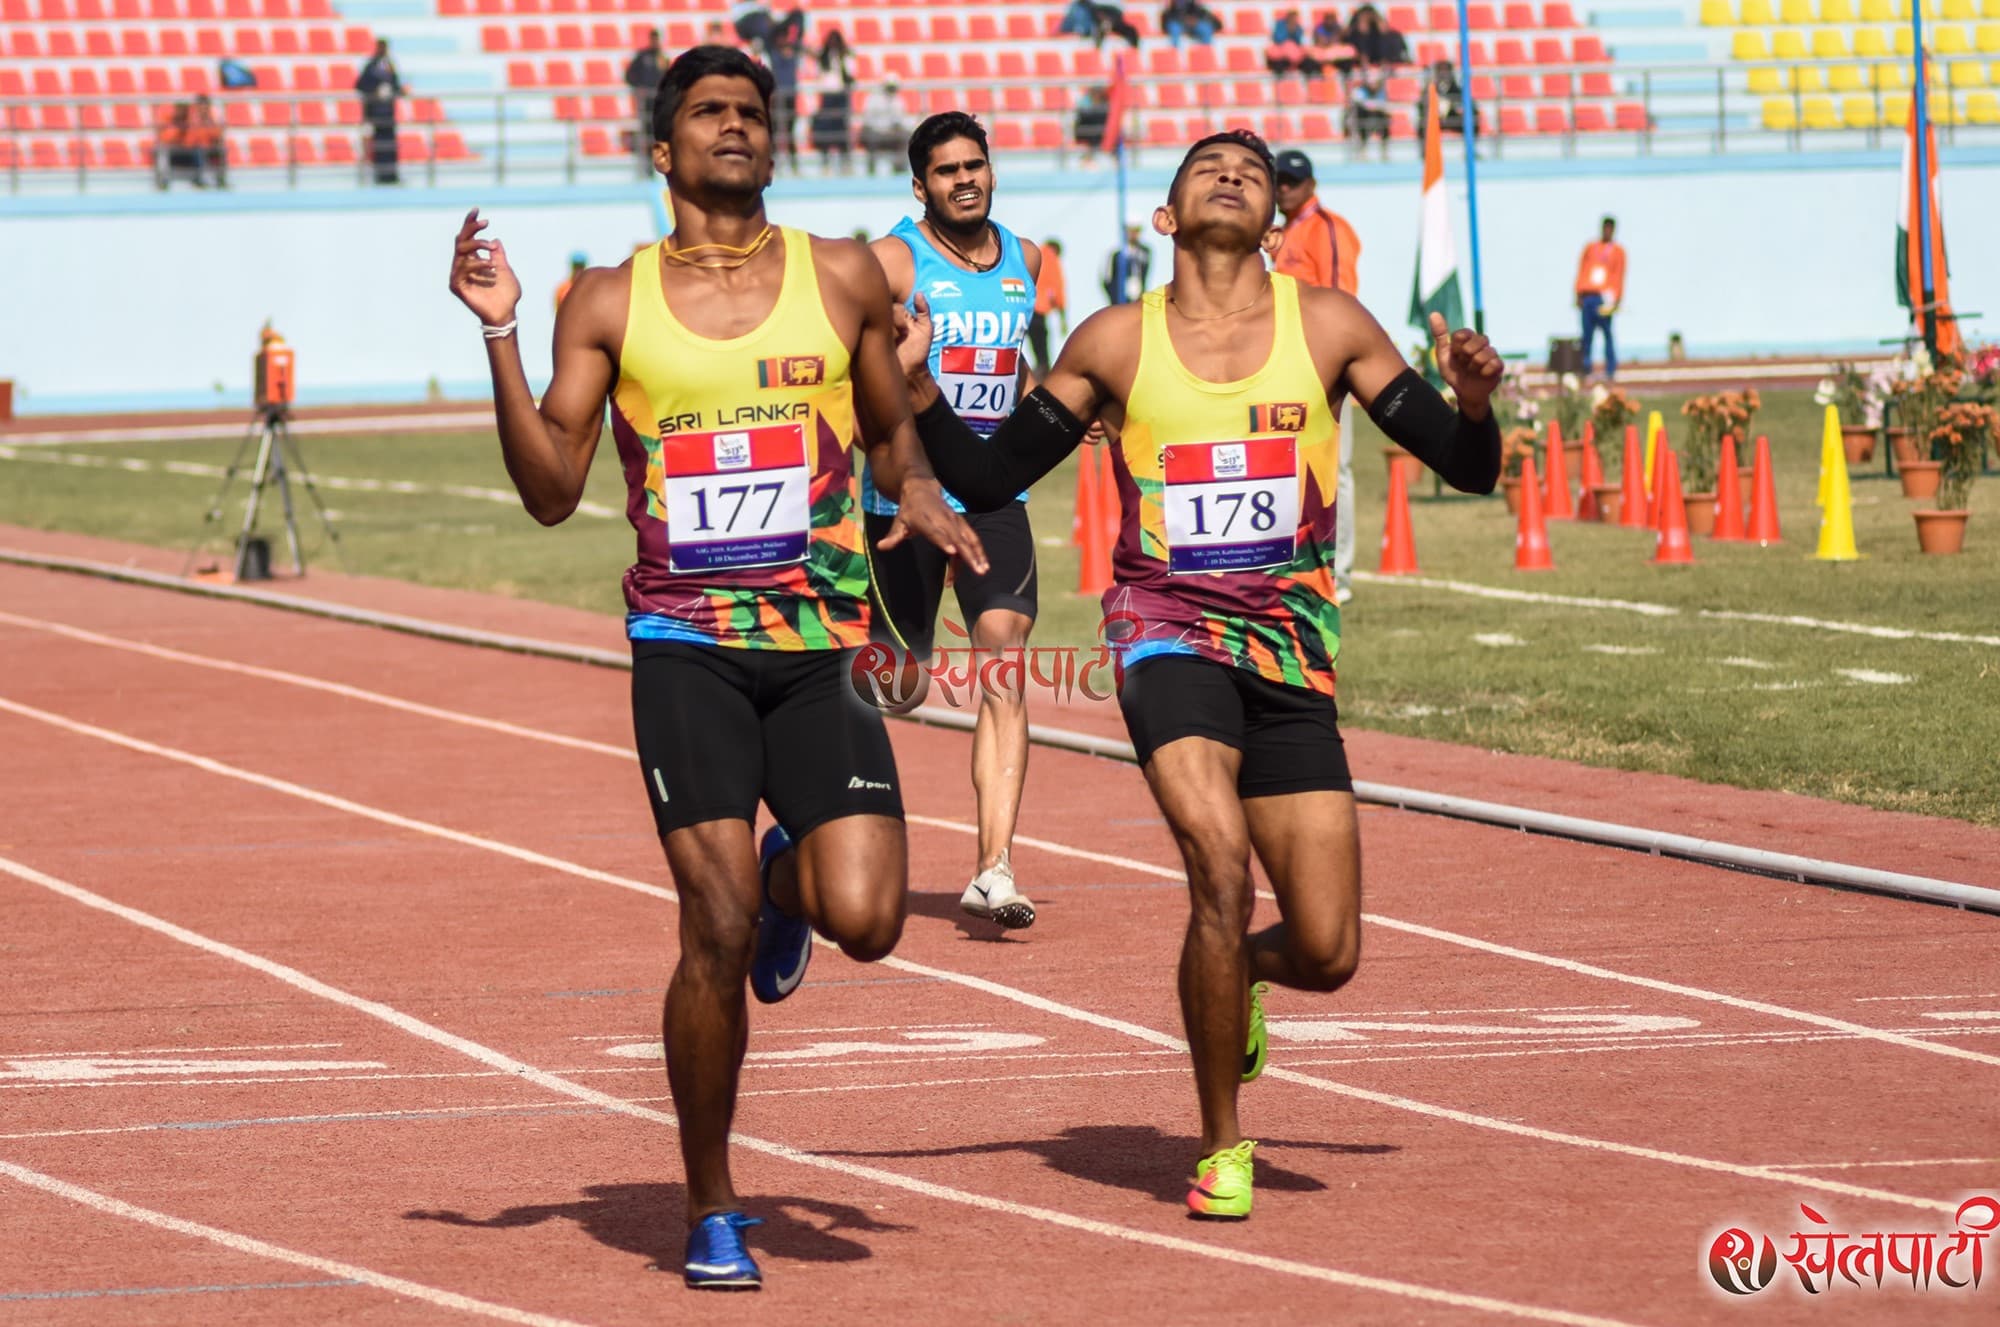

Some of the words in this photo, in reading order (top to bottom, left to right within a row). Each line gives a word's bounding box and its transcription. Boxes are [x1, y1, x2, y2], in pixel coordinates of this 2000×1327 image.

[932, 311, 1029, 344] INDIA
[953, 382, 1006, 411] 120
[658, 411, 702, 434] SRI
[717, 402, 810, 426] LANKA
[690, 481, 785, 533] 177
[1188, 490, 1277, 537] 178
